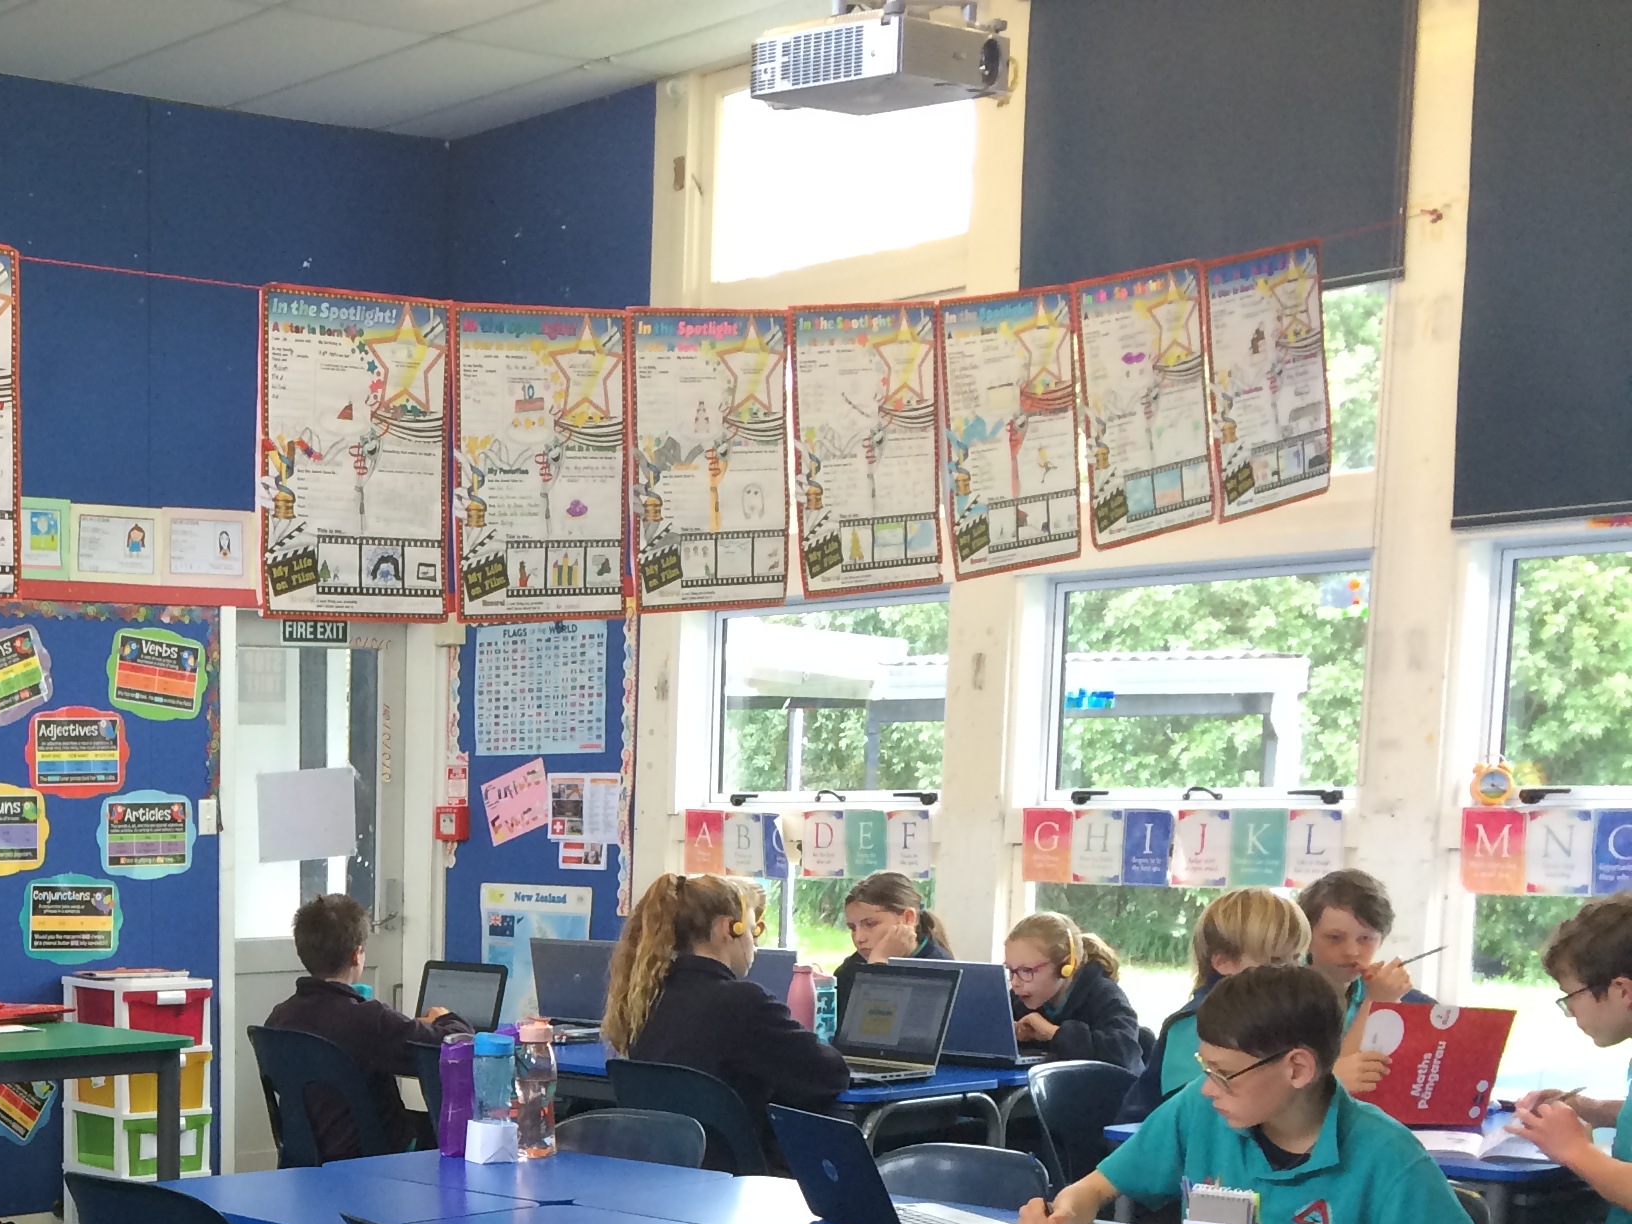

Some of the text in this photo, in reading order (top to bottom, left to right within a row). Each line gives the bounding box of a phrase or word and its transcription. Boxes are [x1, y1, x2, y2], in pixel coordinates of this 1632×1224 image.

[272, 298, 397, 326] In the Spotlight!
[945, 312, 956, 324] In
[272, 322, 342, 337] A Star Is Born
[638, 321, 652, 335] In
[799, 318, 810, 330] In
[814, 317, 834, 329] the
[272, 558, 312, 579] My Life
[468, 563, 502, 583] My Life
[646, 555, 677, 576] My Life
[662, 569, 679, 580] Film
[276, 572, 315, 591] on Film
[471, 577, 505, 595] on Film
[286, 622, 344, 639] FIRE EXIT
[503, 628, 527, 638] FLAGS
[549, 624, 577, 634] WORLD
[142, 640, 178, 658] Verbs
[39, 724, 98, 743] Adjectives
[125, 807, 171, 821] Articles
[695, 821, 714, 848] A
[736, 824, 751, 849] B
[814, 822, 833, 849] D
[859, 821, 873, 848] E
[903, 822, 916, 849] F
[1035, 822, 1060, 851] G
[1085, 824, 1108, 852] H
[1143, 823, 1152, 854] I
[1195, 824, 1205, 855] J
[1247, 823, 1271, 854] K
[1306, 824, 1325, 855] L
[1475, 824, 1512, 857] M
[1543, 825, 1574, 857] N
[33, 889, 90, 903] Conjunctions
[514, 892, 567, 903] New Zealand
[1411, 1052, 1432, 1097] Maths
[1418, 1041, 1447, 1109] Pāngarau
